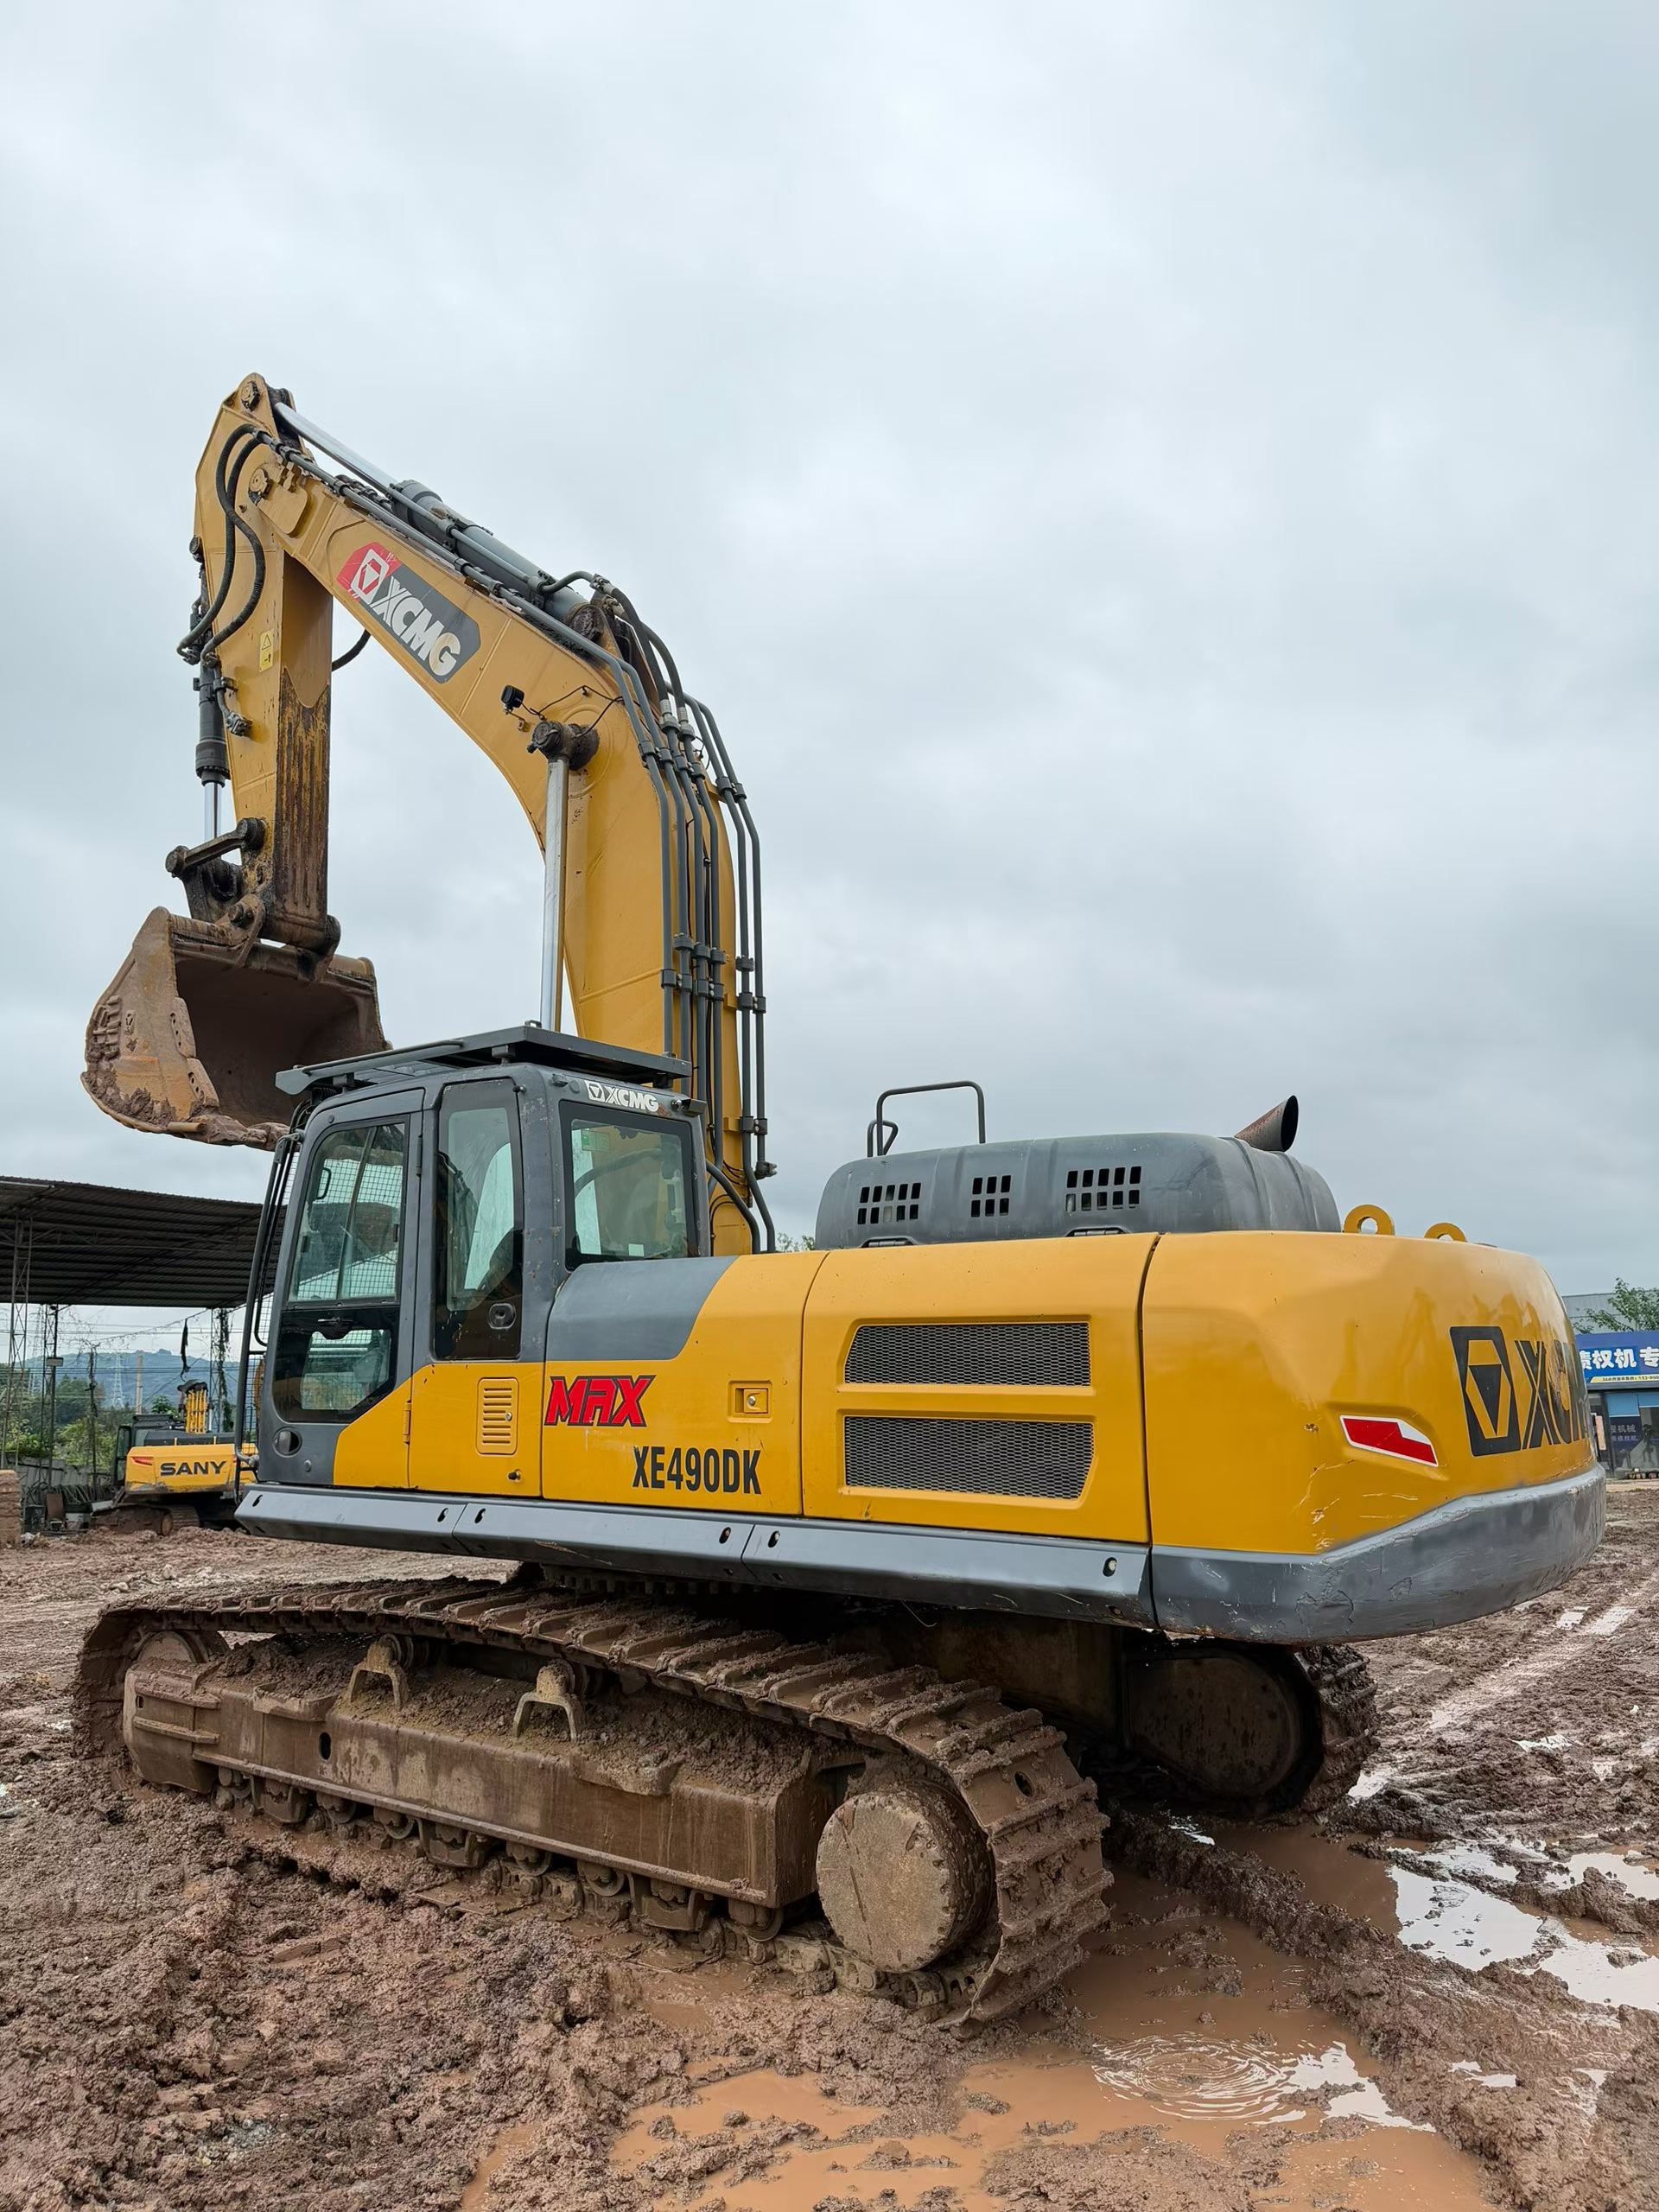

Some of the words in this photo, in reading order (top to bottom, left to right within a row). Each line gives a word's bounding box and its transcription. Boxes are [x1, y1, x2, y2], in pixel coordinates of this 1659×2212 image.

[369, 575, 461, 676] XCMG
[604, 1085, 658, 1112] XCMG
[544, 1374, 657, 1427] MAX
[160, 1461, 226, 1477] SANY
[632, 1446, 761, 1494] XE490DK
